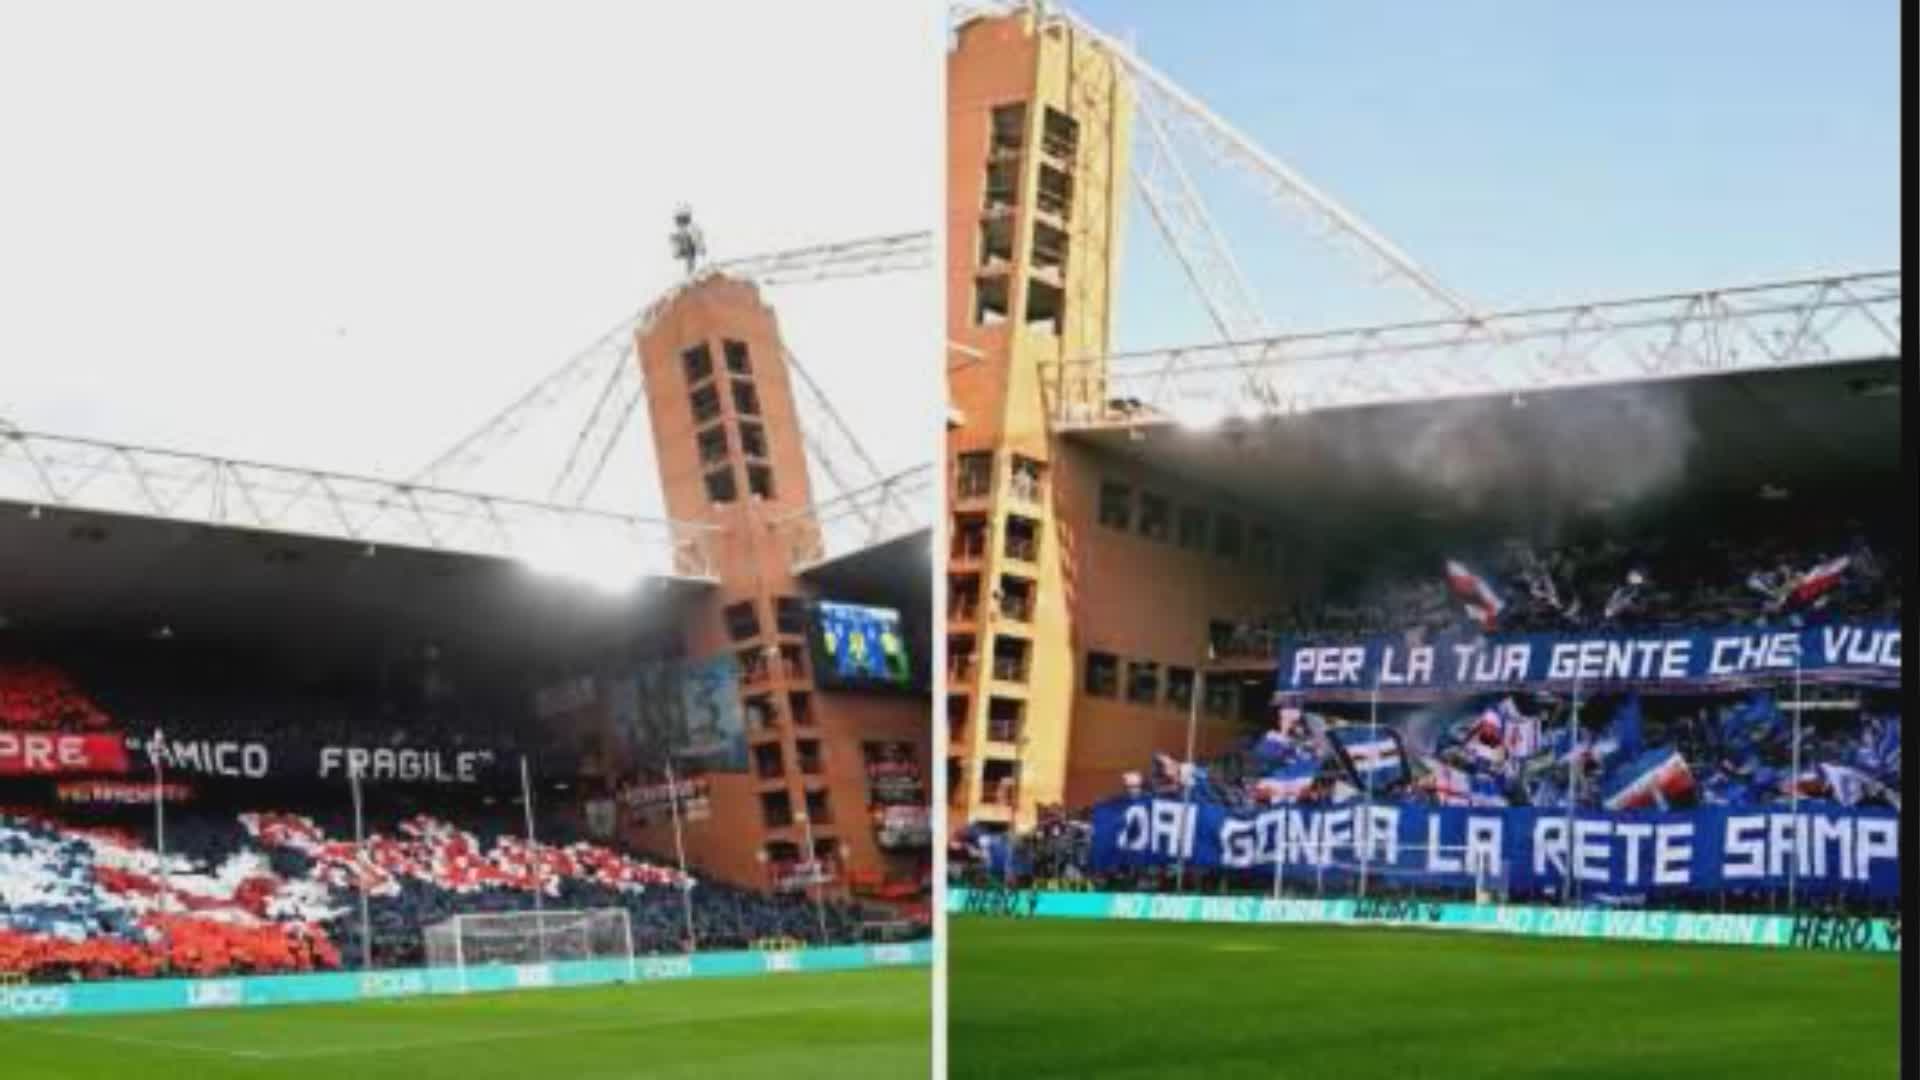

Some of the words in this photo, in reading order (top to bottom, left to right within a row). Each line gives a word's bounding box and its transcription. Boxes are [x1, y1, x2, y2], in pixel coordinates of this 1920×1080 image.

[1291, 646, 1364, 686] PER
[1380, 644, 1435, 684] LA
[1454, 643, 1531, 681] TUA
[1546, 640, 1692, 678] GENTE
[1711, 632, 1799, 674] CHE
[1220, 804, 1399, 867] GONFIA
[1427, 814, 1502, 876] LA
[1533, 816, 1695, 884] RETE
[1722, 814, 1900, 880] SAMP
